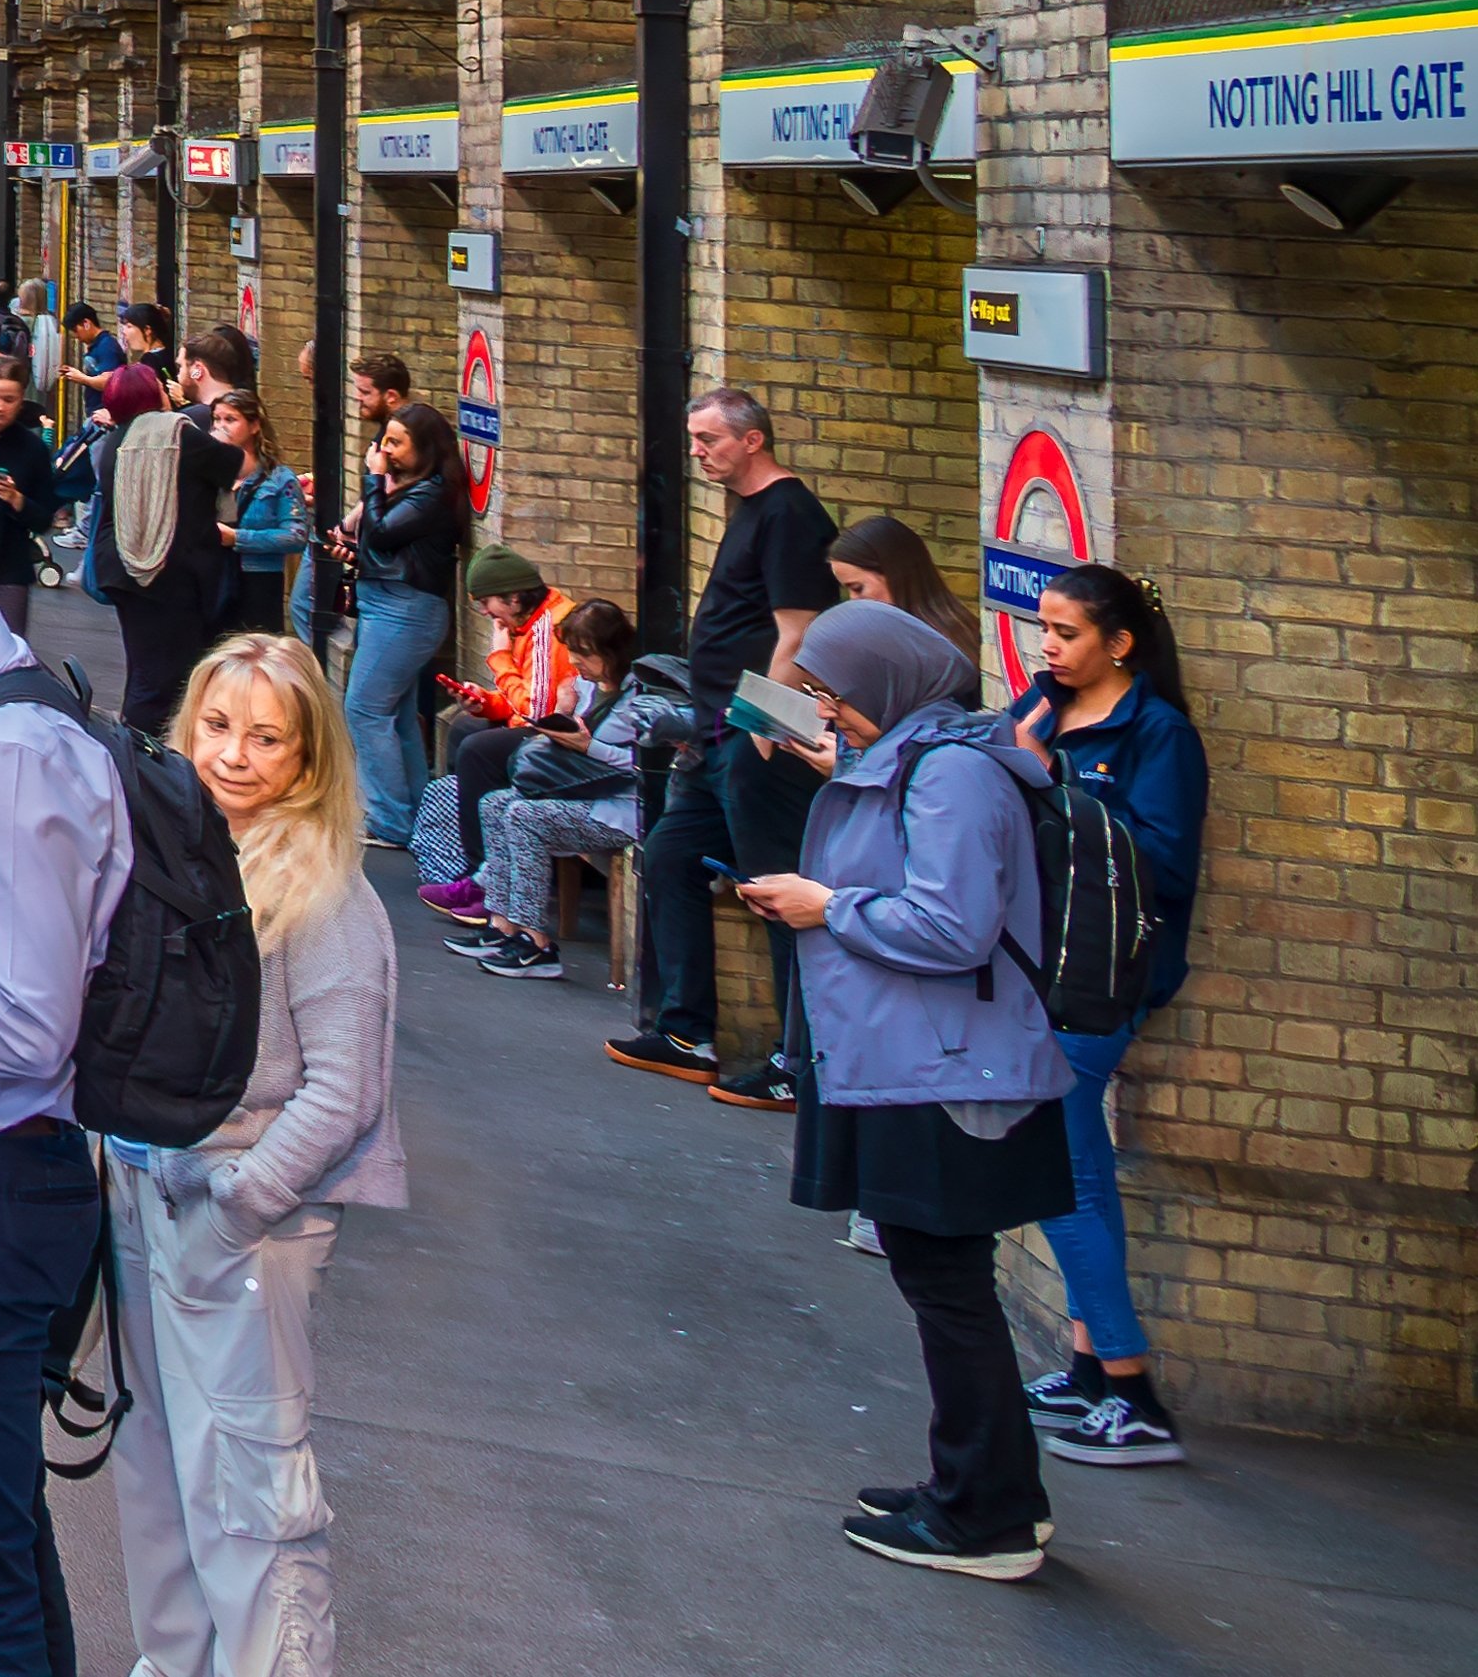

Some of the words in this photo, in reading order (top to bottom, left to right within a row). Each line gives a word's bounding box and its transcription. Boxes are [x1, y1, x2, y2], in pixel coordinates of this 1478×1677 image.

[1209, 72, 1318, 128] NOTTING
[1327, 68, 1382, 123] HILL
[1390, 61, 1466, 121] GATE
[772, 104, 829, 141] NOTTING
[978, 299, 995, 325] Way
[996, 303, 1011, 322] out
[989, 559, 1039, 599] NOTTING
